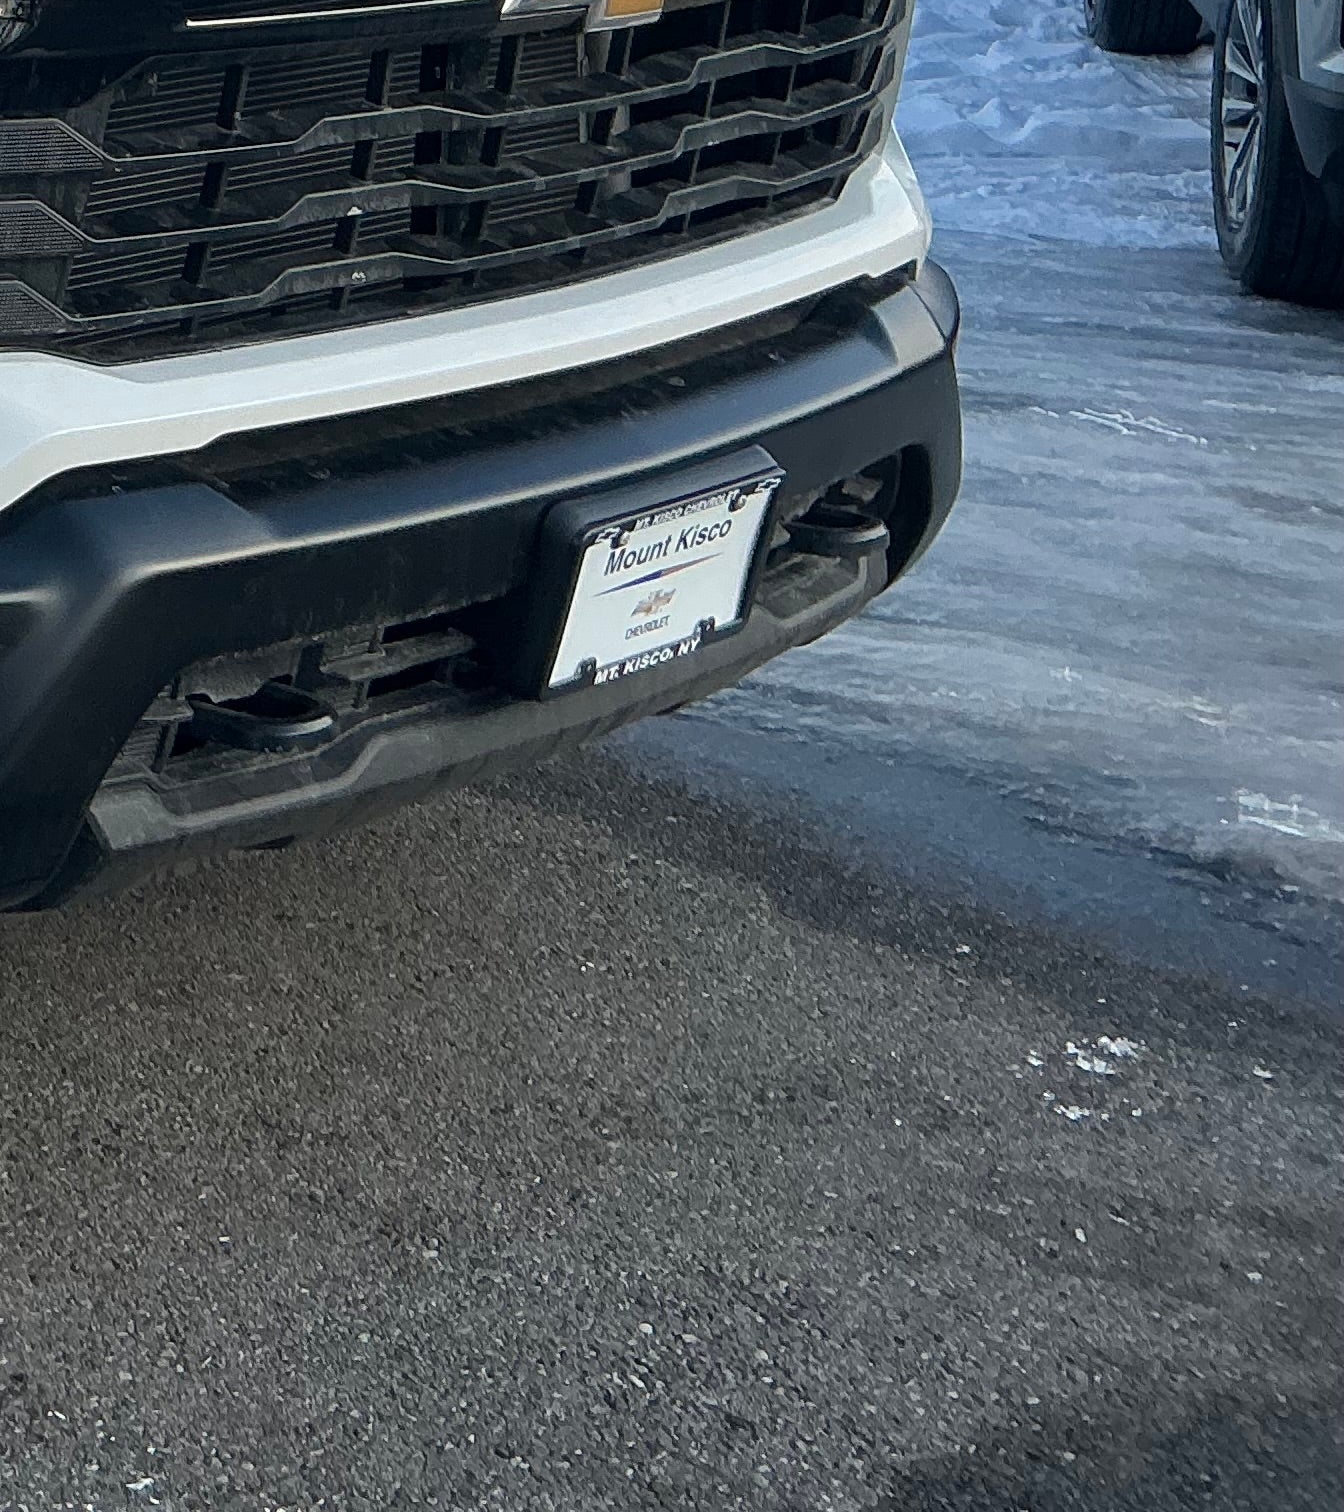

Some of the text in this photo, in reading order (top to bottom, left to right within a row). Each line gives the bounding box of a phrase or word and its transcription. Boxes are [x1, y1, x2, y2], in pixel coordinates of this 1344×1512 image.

[603, 518, 732, 577] Mount Kisco
[624, 614, 672, 640] CHEVROLET
[593, 666, 619, 686] MT.
[676, 636, 702, 657] NY
